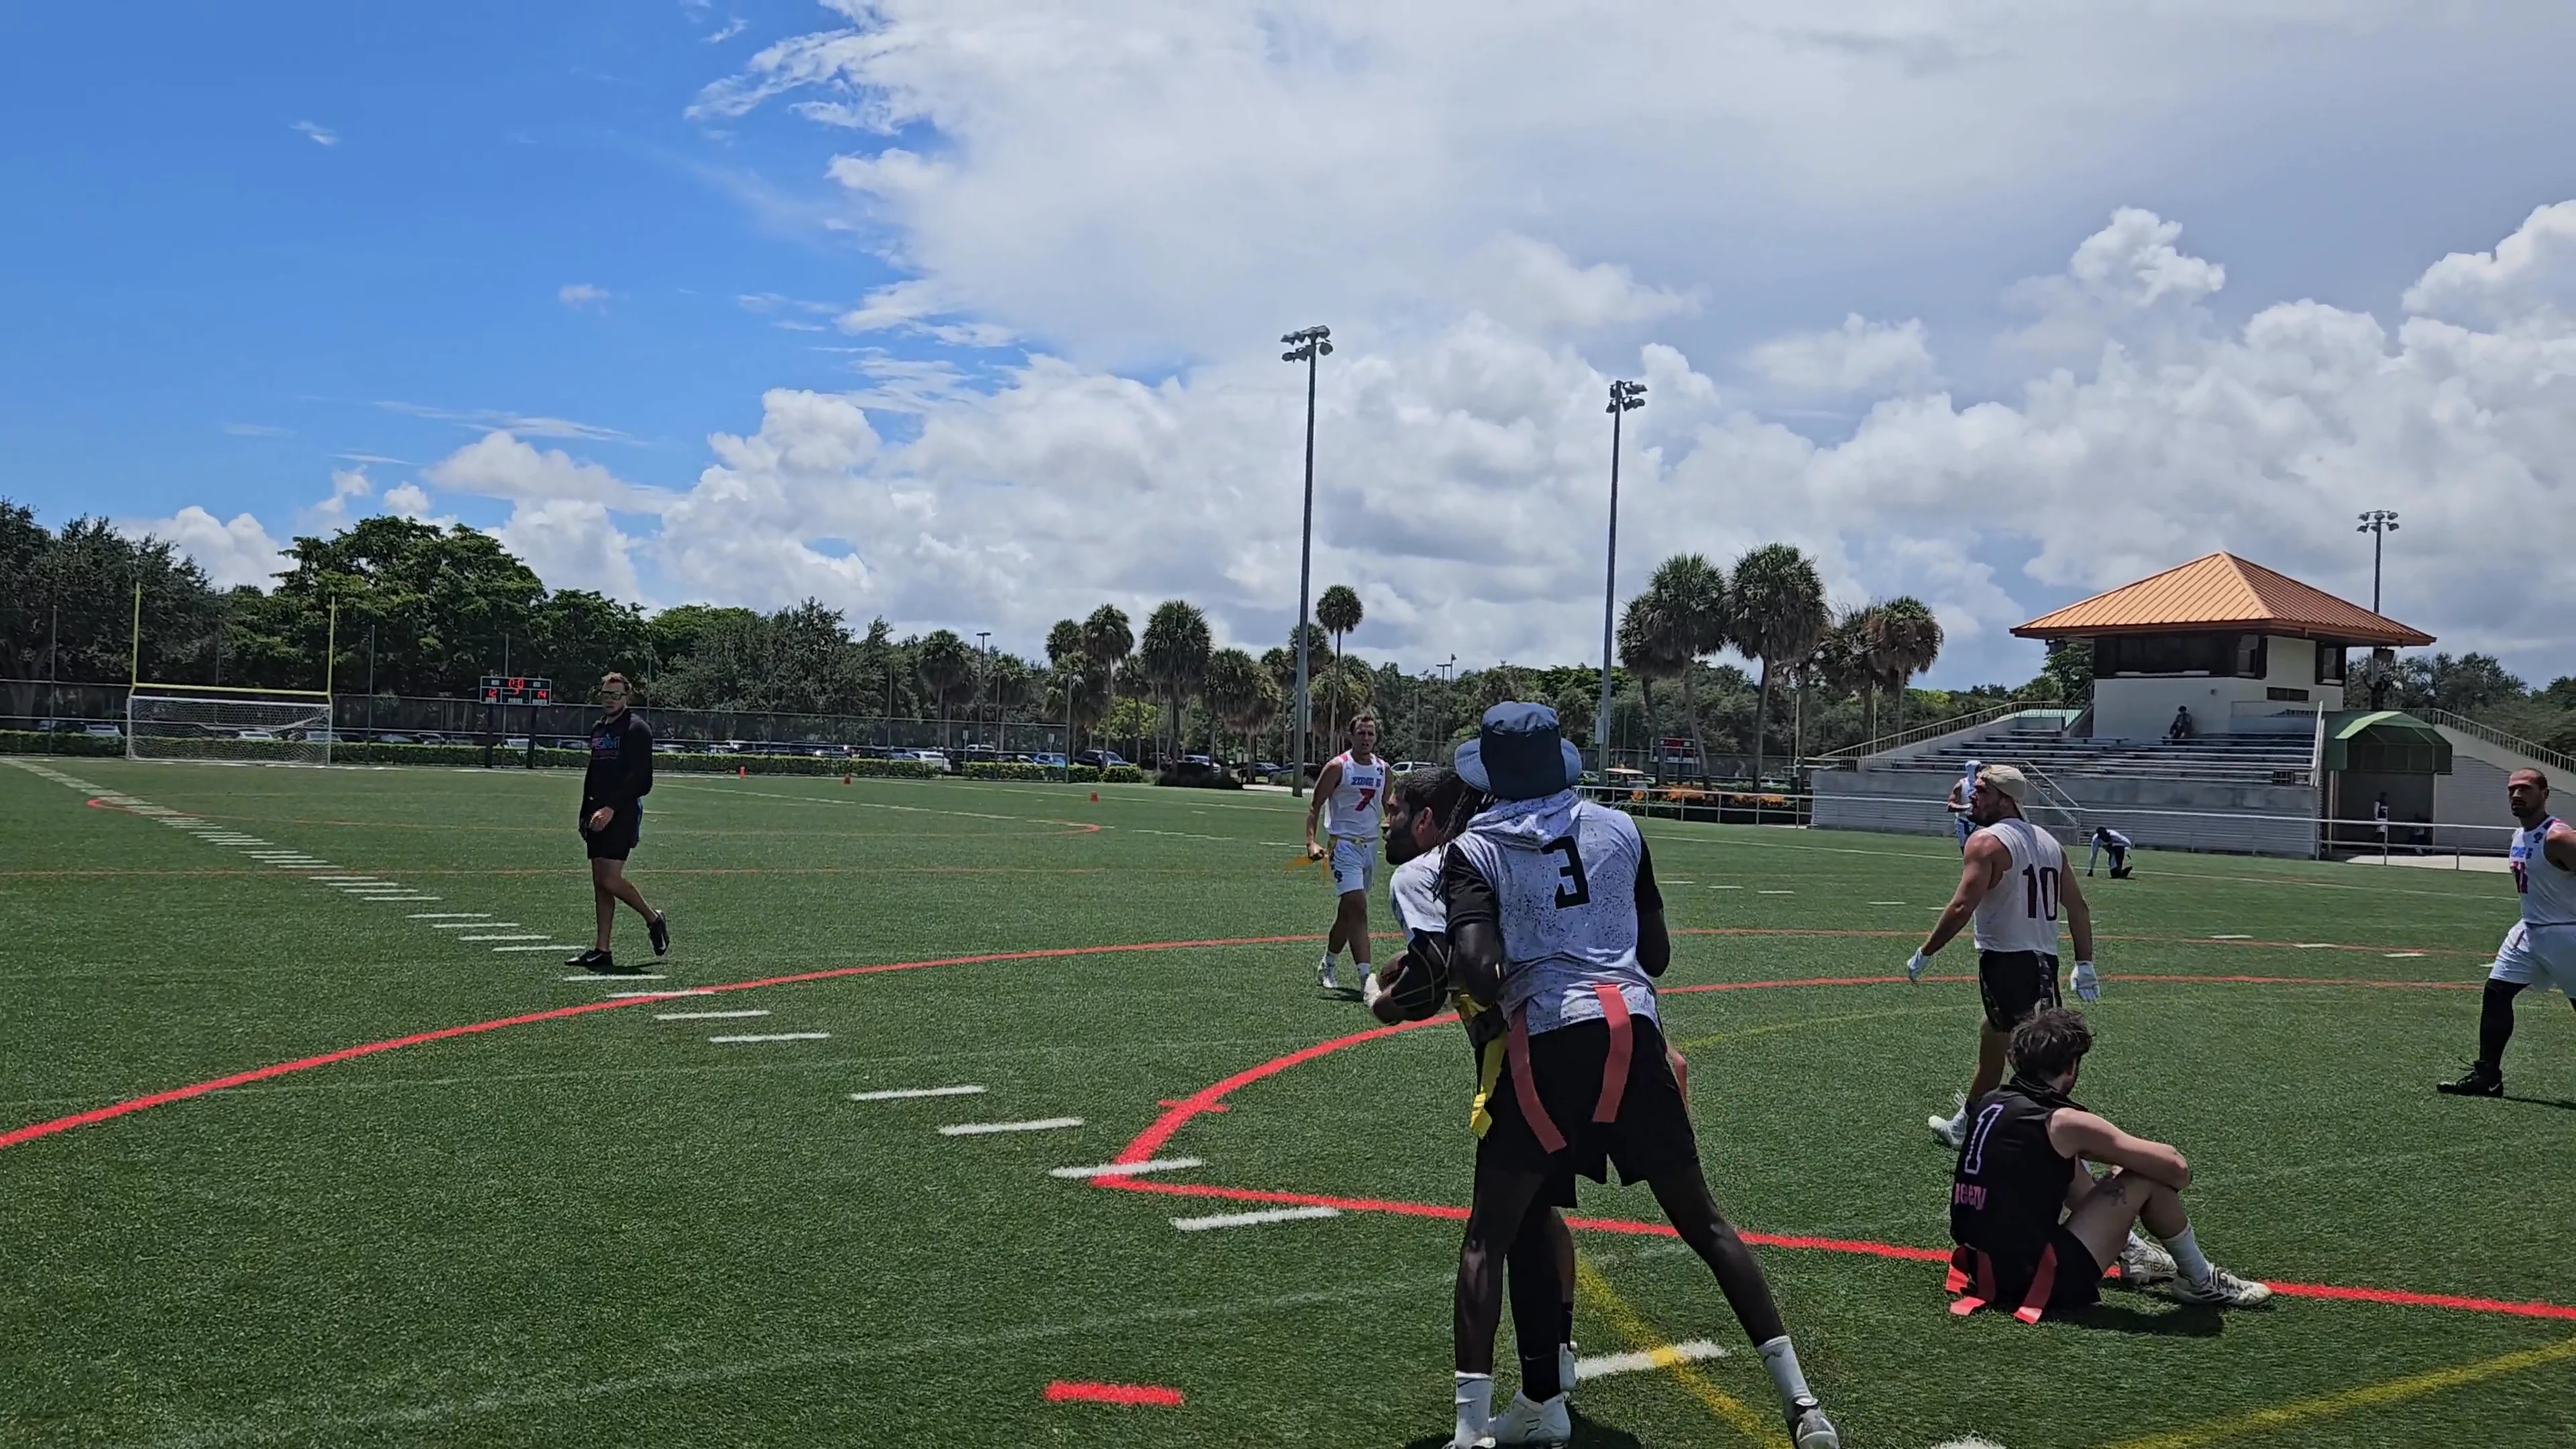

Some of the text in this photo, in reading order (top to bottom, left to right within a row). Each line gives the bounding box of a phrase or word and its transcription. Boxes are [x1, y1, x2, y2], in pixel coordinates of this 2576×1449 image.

[1355, 788, 1377, 812] 7
[1540, 835, 1591, 910] 3
[2022, 863, 2059, 921] 10
[1964, 1104, 2004, 1175] 1
